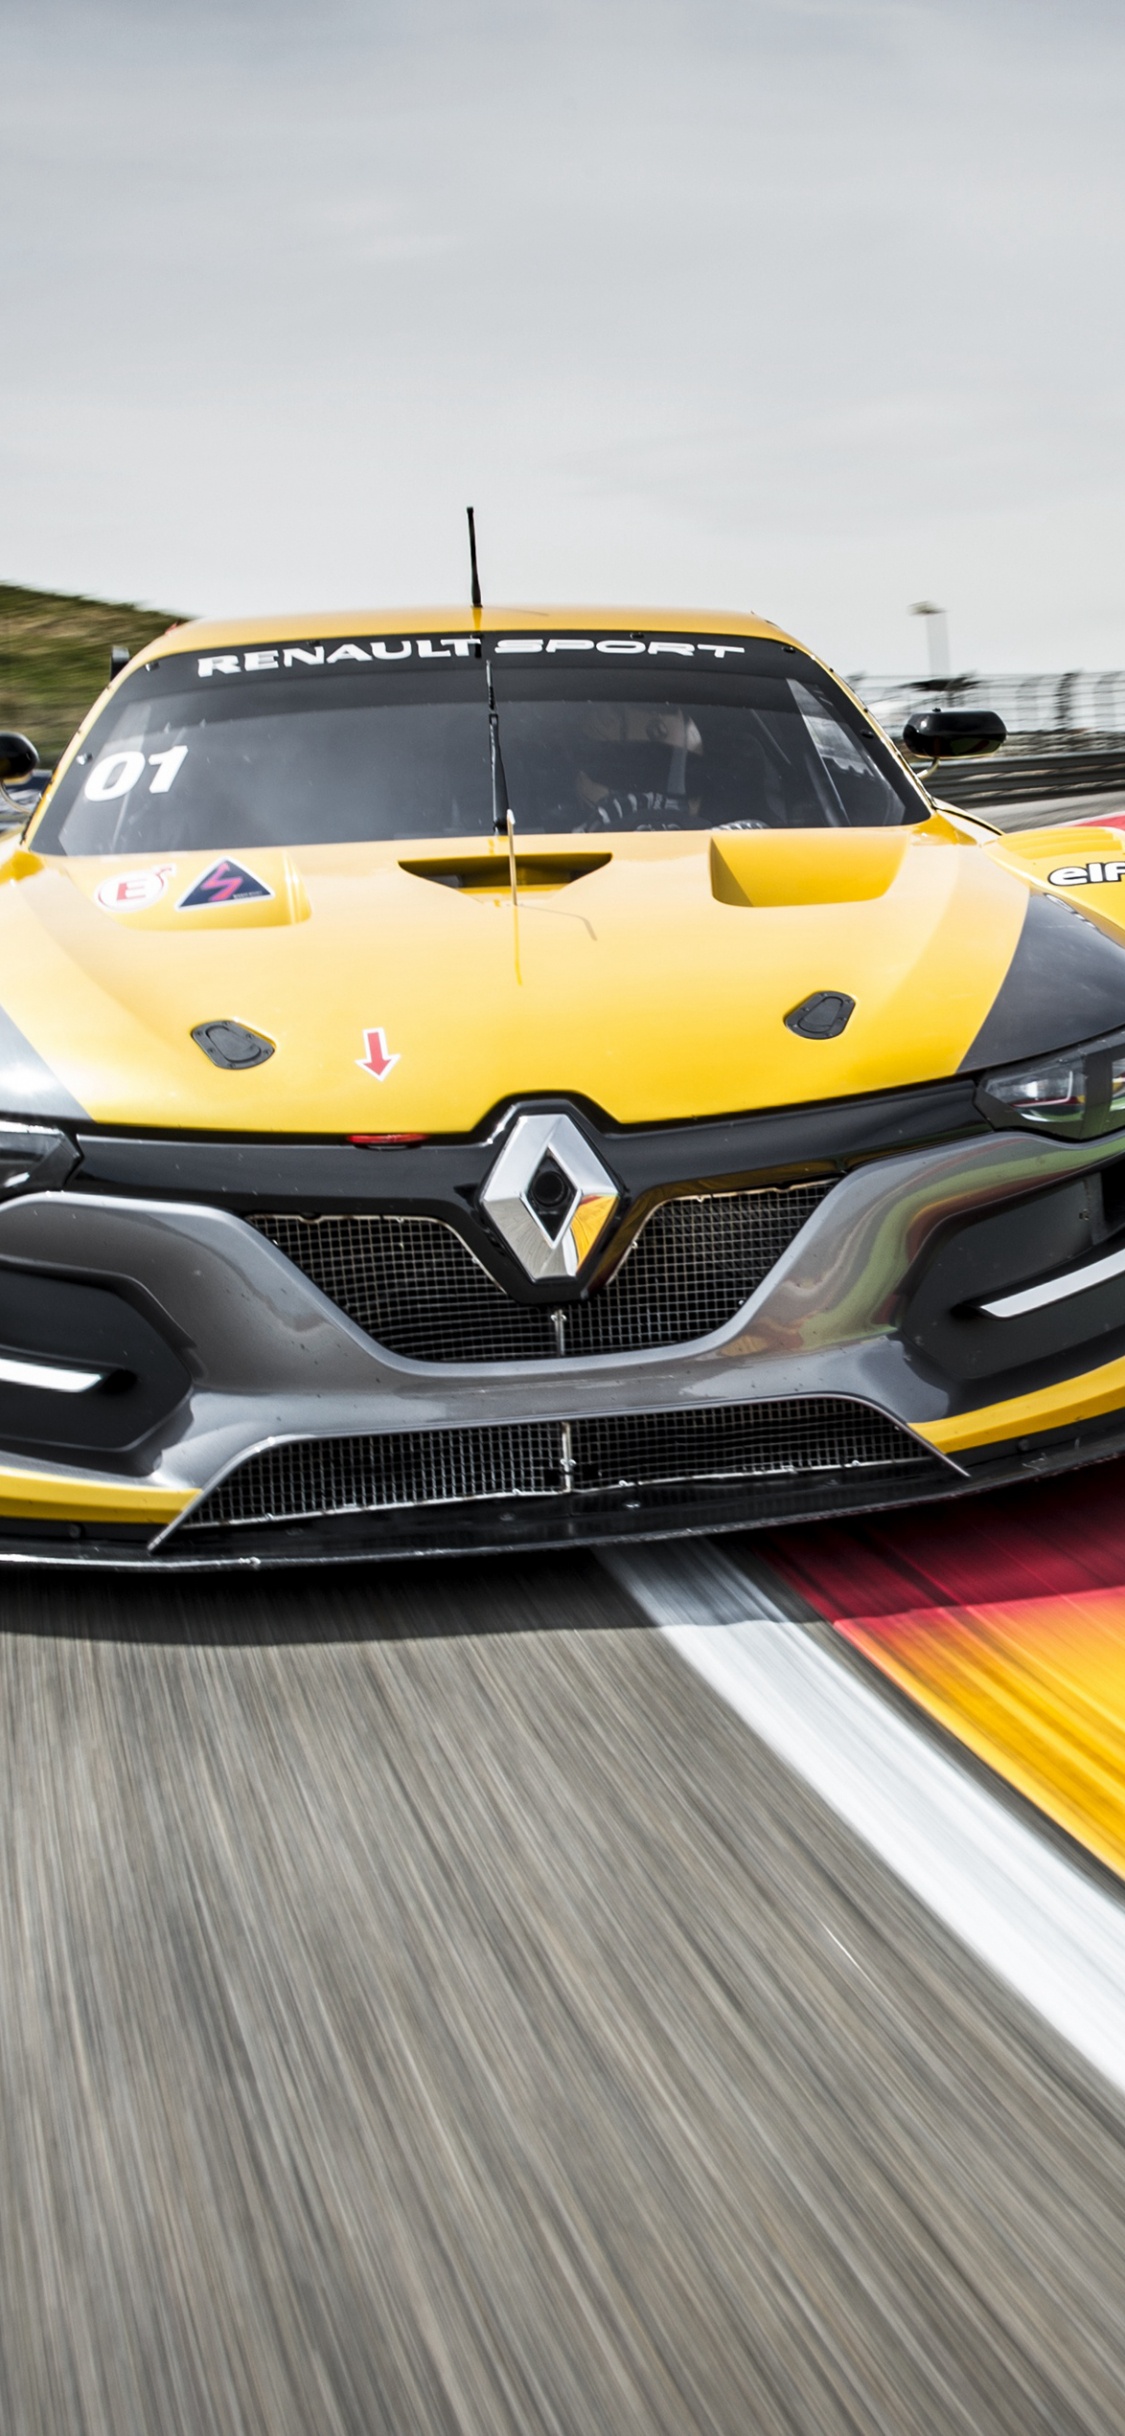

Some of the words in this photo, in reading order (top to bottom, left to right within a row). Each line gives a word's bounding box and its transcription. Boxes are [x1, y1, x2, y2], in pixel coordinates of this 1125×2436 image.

[197, 638, 481, 678] RENAULT
[494, 638, 746, 659] SPORT
[84, 745, 189, 802] 01
[116, 878, 148, 901] E
[1047, 861, 1125, 887] elf
